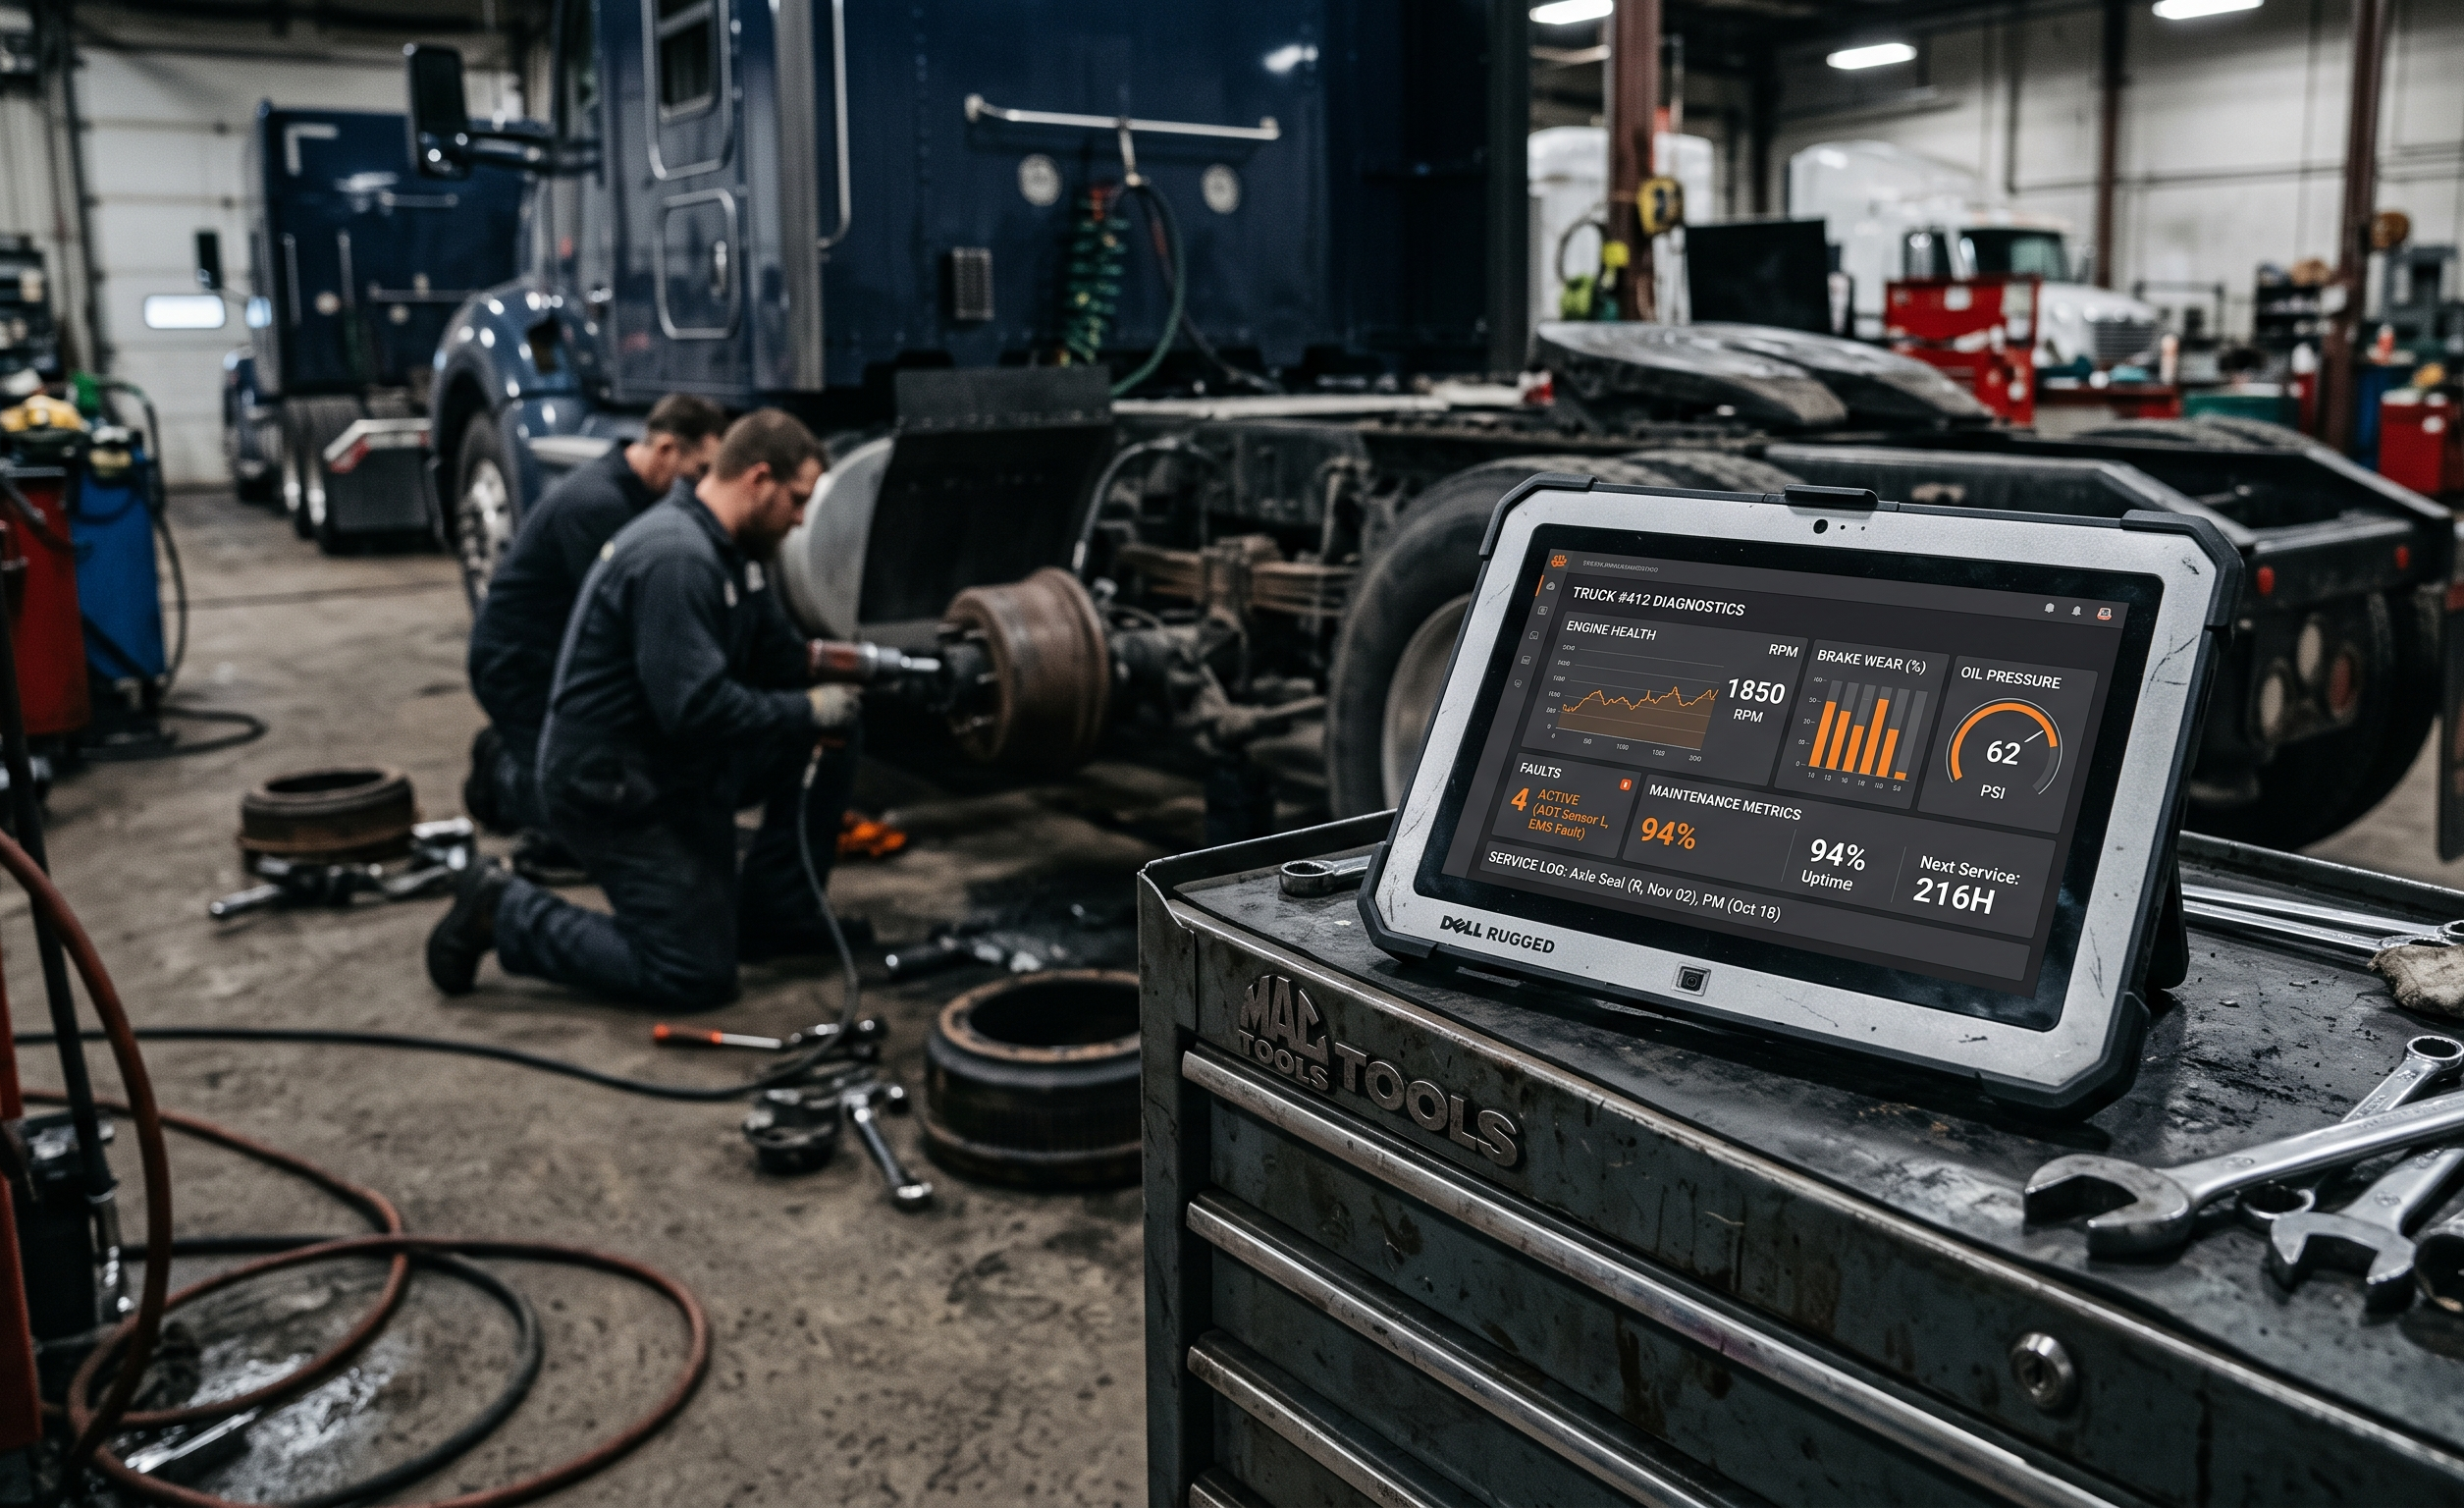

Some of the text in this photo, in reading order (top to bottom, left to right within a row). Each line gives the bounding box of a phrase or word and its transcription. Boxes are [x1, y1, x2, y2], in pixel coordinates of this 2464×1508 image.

[1574, 586, 1746, 617] TRUCK #412 DIAGNOSTICS
[1566, 620, 1657, 641] ENGINE HEALTH
[1768, 643, 1798, 658] RPM
[1817, 649, 1927, 675] BRAKE WEAR (%)
[1727, 677, 1786, 705] 1850
[1960, 666, 2062, 690] OIL PRESSURE
[1733, 708, 1763, 724] RPM
[1985, 740, 2021, 766] 62
[1520, 762, 1562, 779] FAULTS
[1510, 787, 1580, 812] 4 ACTIVE
[1648, 783, 1802, 821] MAINTENANCE METRICS
[1980, 784, 2006, 800] PSI
[1527, 818, 1585, 841] EMS Fault)
[1561, 809, 1598, 826] Sensor
[1640, 816, 1696, 850] 94%
[1809, 837, 1866, 872] 94%
[1800, 869, 1853, 891] Uptime
[1919, 854, 2021, 886] Next Service:
[1488, 850, 1782, 924] SERVICE LOG: Axle Seal (R, Nov 02), PM (Oct 18)
[1913, 878, 1996, 915] 216H
[1439, 915, 1555, 954] DELL RUGGED
[1239, 974, 1329, 1066] MAC
[1238, 1029, 1329, 1091] TOOLS
[1334, 1042, 1519, 1167] TOOLS
